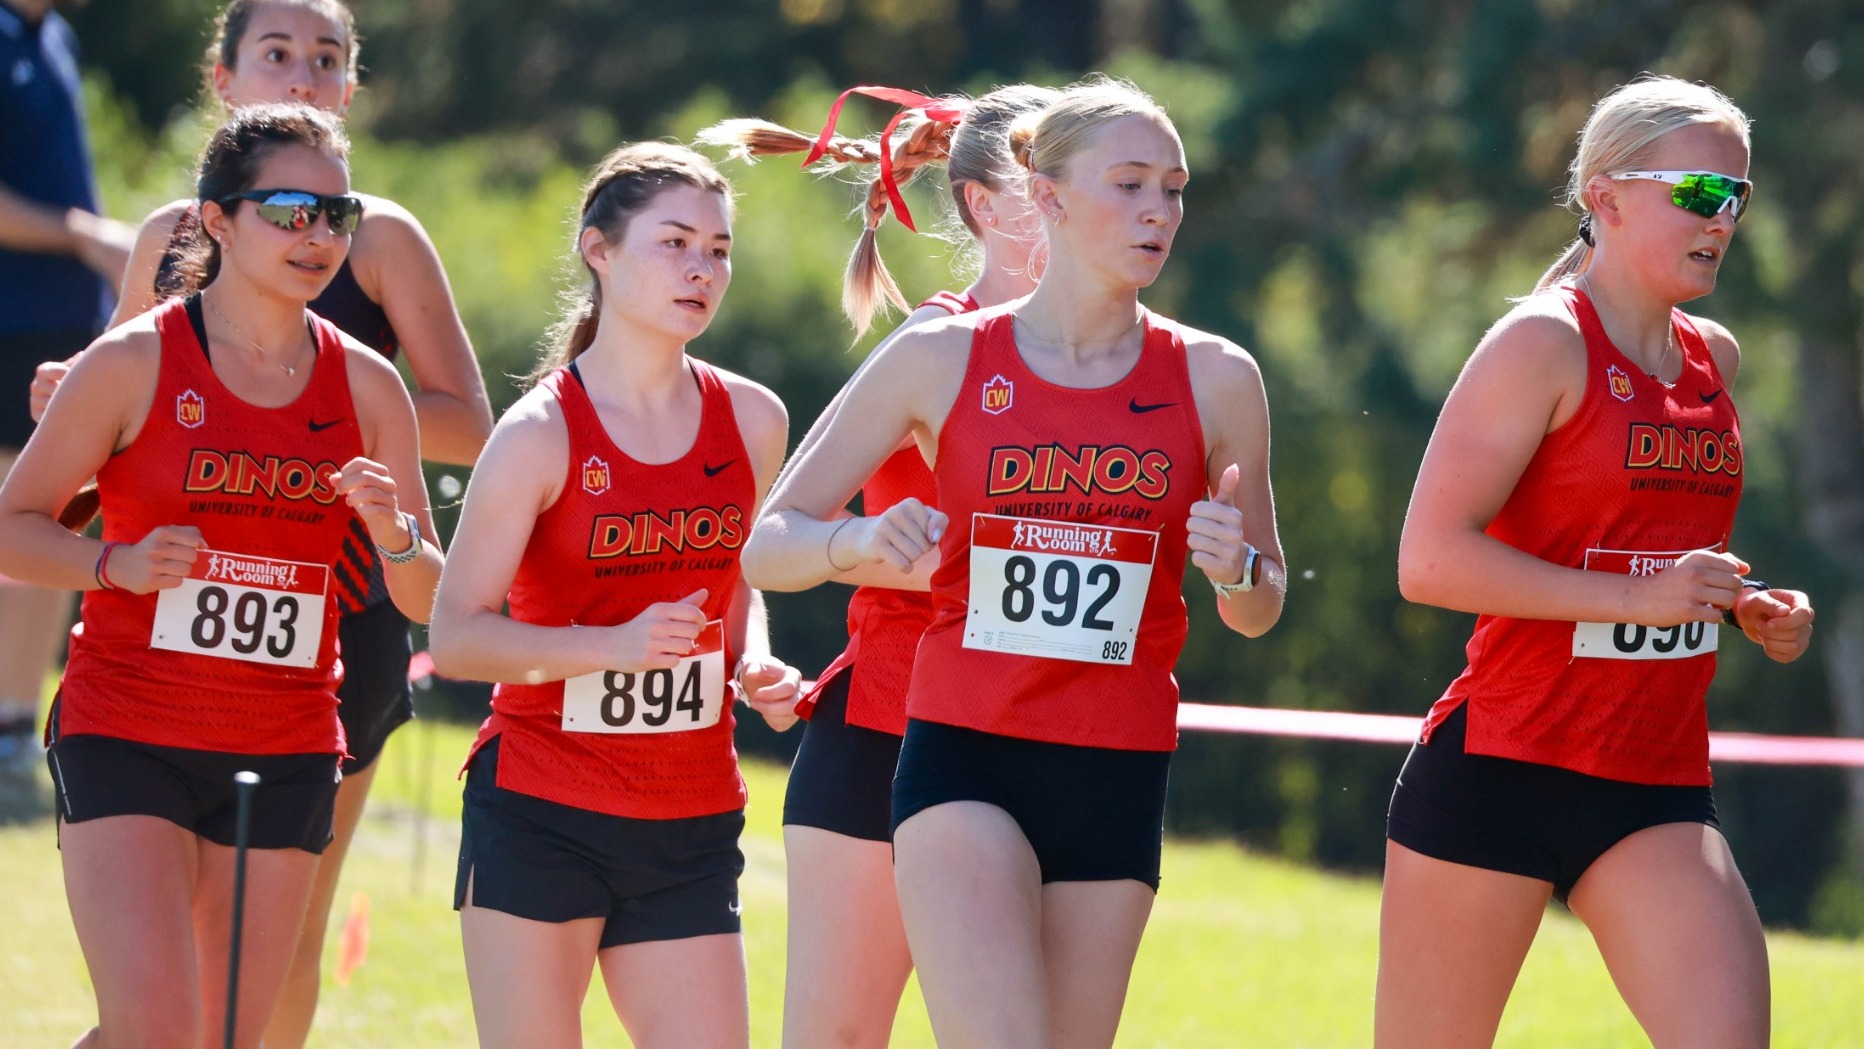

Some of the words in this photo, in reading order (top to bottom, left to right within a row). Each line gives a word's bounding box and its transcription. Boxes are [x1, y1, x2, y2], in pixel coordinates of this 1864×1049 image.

[1612, 377, 1631, 394] CW
[985, 389, 1009, 407] CW
[180, 403, 200, 421] CW
[1624, 421, 1740, 478] DINOS
[184, 448, 341, 505] DINOS
[585, 469, 606, 488] CW
[986, 441, 1173, 502] DINOS
[1630, 477, 1686, 492] UNIVERSITY
[1687, 480, 1699, 493] OF
[1700, 480, 1735, 497] CALGARY
[189, 501, 258, 517] UNIVERSITY
[260, 506, 273, 519] OF
[277, 509, 326, 524] CALGARY
[995, 502, 1073, 517] UNIVERSITY
[1077, 502, 1093, 515] OF
[1099, 502, 1153, 522] CALGARY
[587, 504, 744, 560] DINOS
[1025, 524, 1102, 550] Running
[219, 557, 289, 583] Running
[595, 561, 667, 578] UNIVERSITY
[669, 559, 686, 572] OF
[688, 557, 734, 571] CALGARY
[1002, 555, 1121, 632] 892
[191, 586, 299, 658] 893
[1102, 640, 1128, 660] 892
[600, 660, 704, 727] 894
